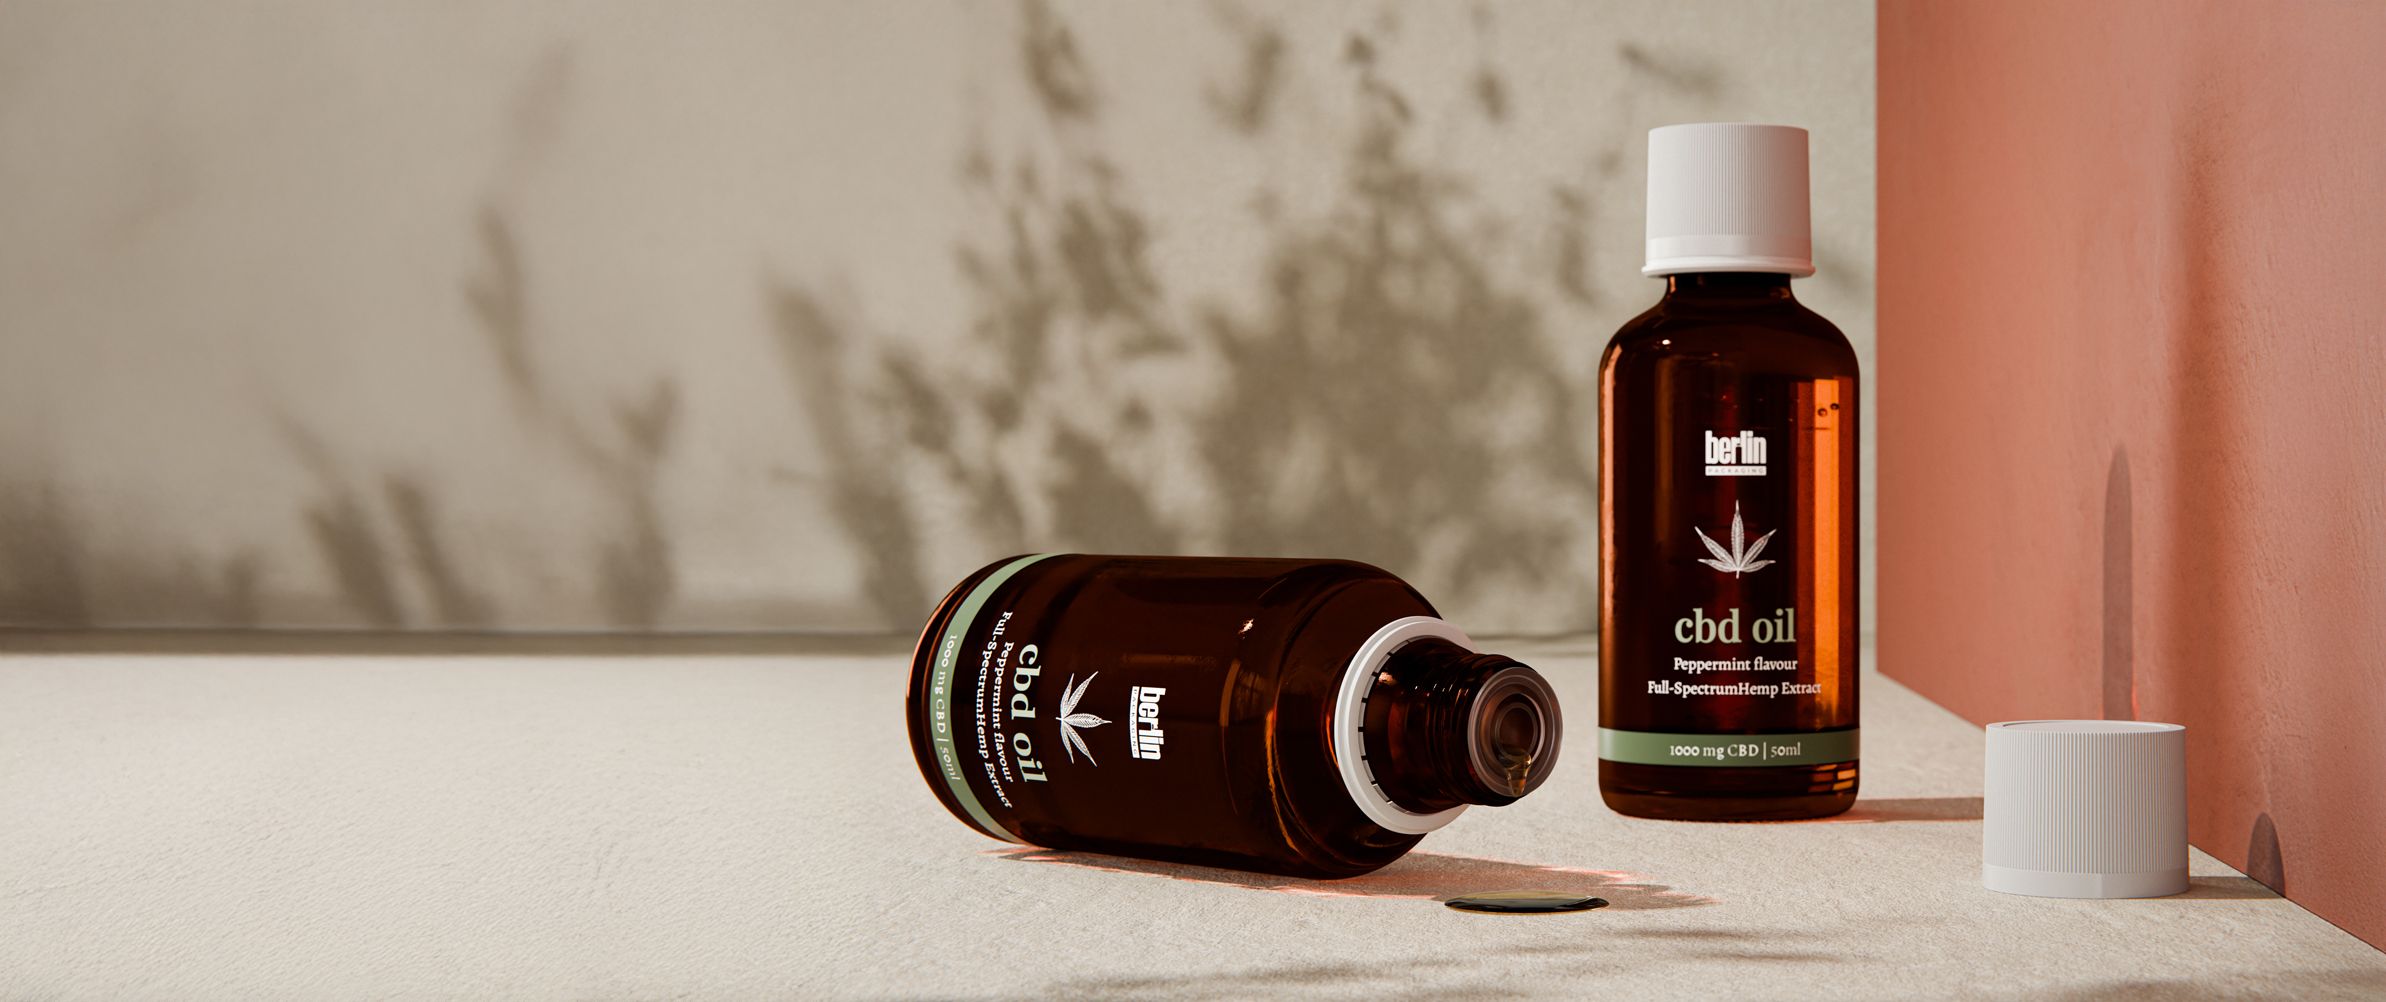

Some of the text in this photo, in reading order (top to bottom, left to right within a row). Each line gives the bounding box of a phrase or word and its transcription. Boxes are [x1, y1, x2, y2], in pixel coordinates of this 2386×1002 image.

[1705, 430, 1766, 464] berlin
[1674, 608, 1796, 644] cbd oil
[941, 634, 958, 667] 1000
[1674, 657, 1797, 674] Peppermint flavour
[935, 671, 948, 694] mg
[1782, 682, 1821, 694] Extract
[935, 699, 946, 733] CBD
[992, 641, 1014, 782] Peppermint flavour
[1011, 644, 1047, 782] cbd oil
[1138, 687, 1166, 760] berlin
[939, 747, 960, 780] 50ml
[1670, 745, 1699, 756] 1000
[1703, 747, 1724, 760] mg
[1728, 744, 1759, 757] CBD
[1771, 742, 1800, 759] 50ml
[984, 762, 1013, 808] Extract
